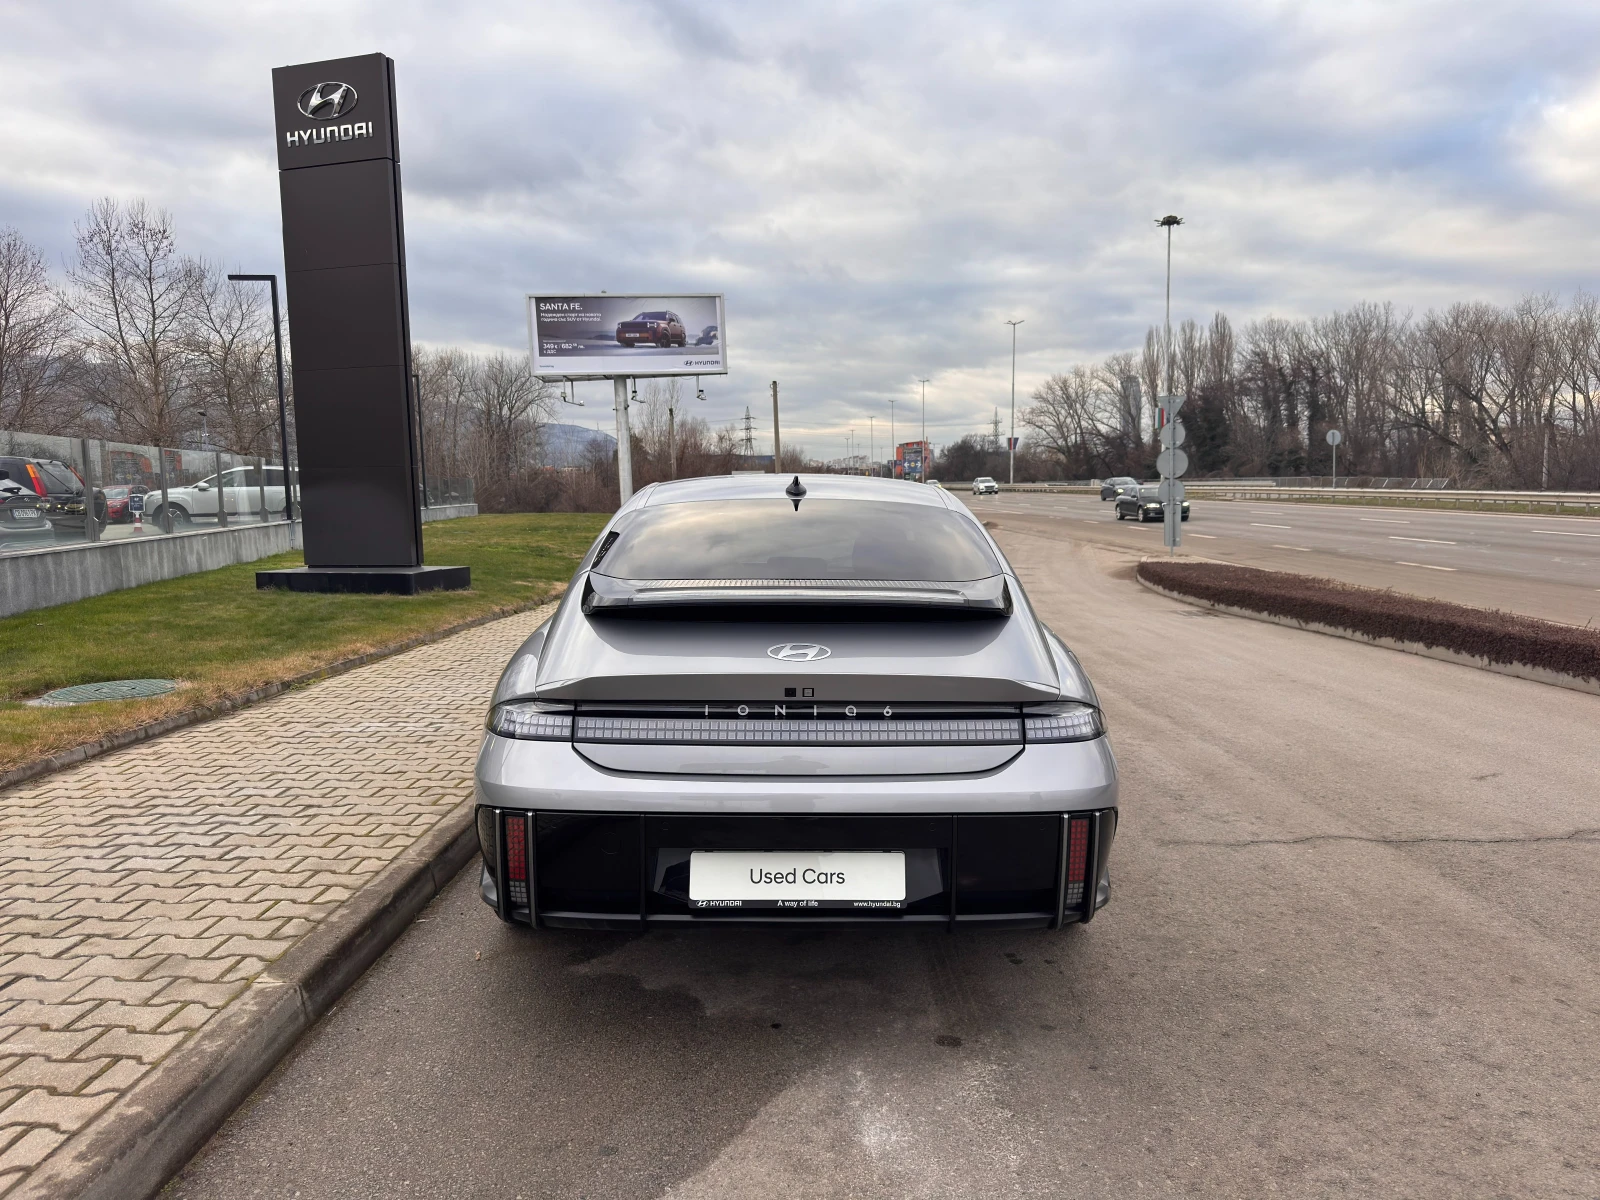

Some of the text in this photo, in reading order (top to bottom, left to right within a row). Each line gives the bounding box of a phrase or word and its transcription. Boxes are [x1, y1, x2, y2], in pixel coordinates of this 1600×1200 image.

[286, 122, 373, 147] HYUNDAI
[705, 705, 893, 717] IONIQ 6
[750, 868, 846, 885] Used Cars
[853, 900, 901, 908] www.hyundai.bg
